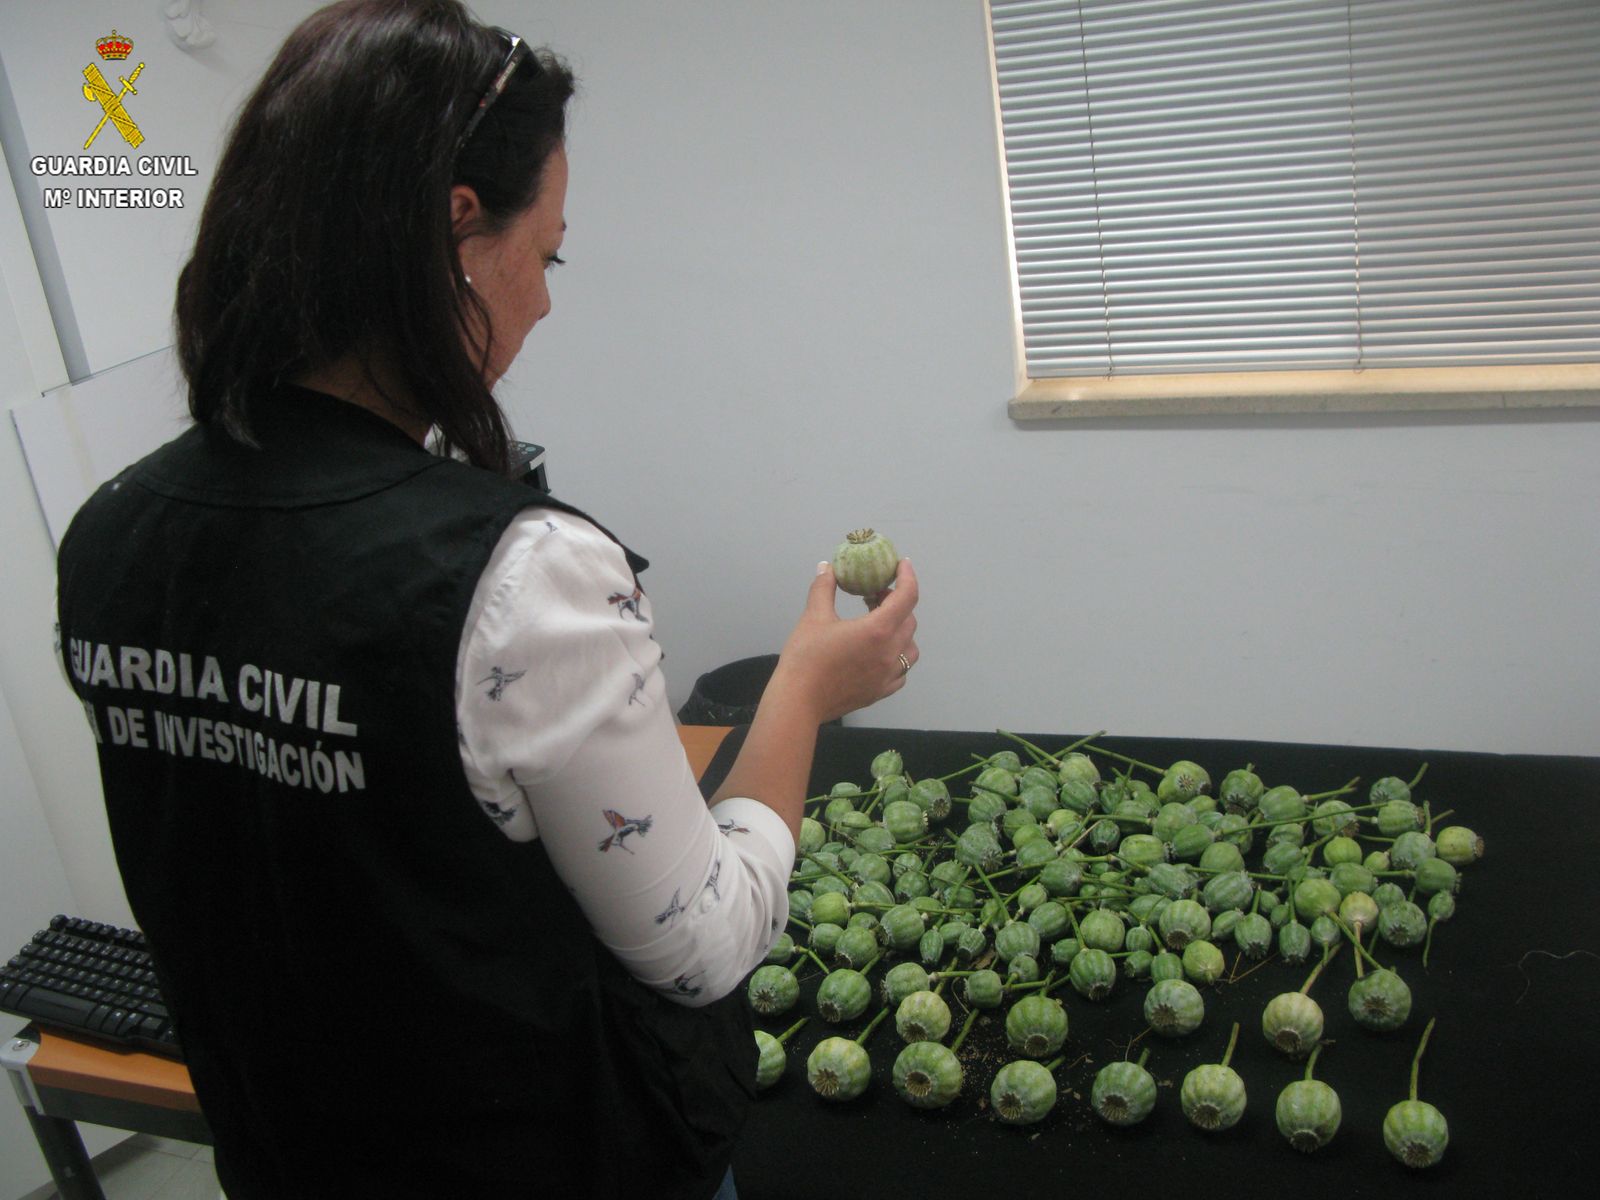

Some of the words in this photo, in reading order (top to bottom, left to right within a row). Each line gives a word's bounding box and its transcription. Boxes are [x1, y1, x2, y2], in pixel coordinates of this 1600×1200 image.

[238, 664, 358, 737] CIVIL
[107, 706, 149, 748] DE
[154, 710, 366, 794] INVESTIGACIÓN
